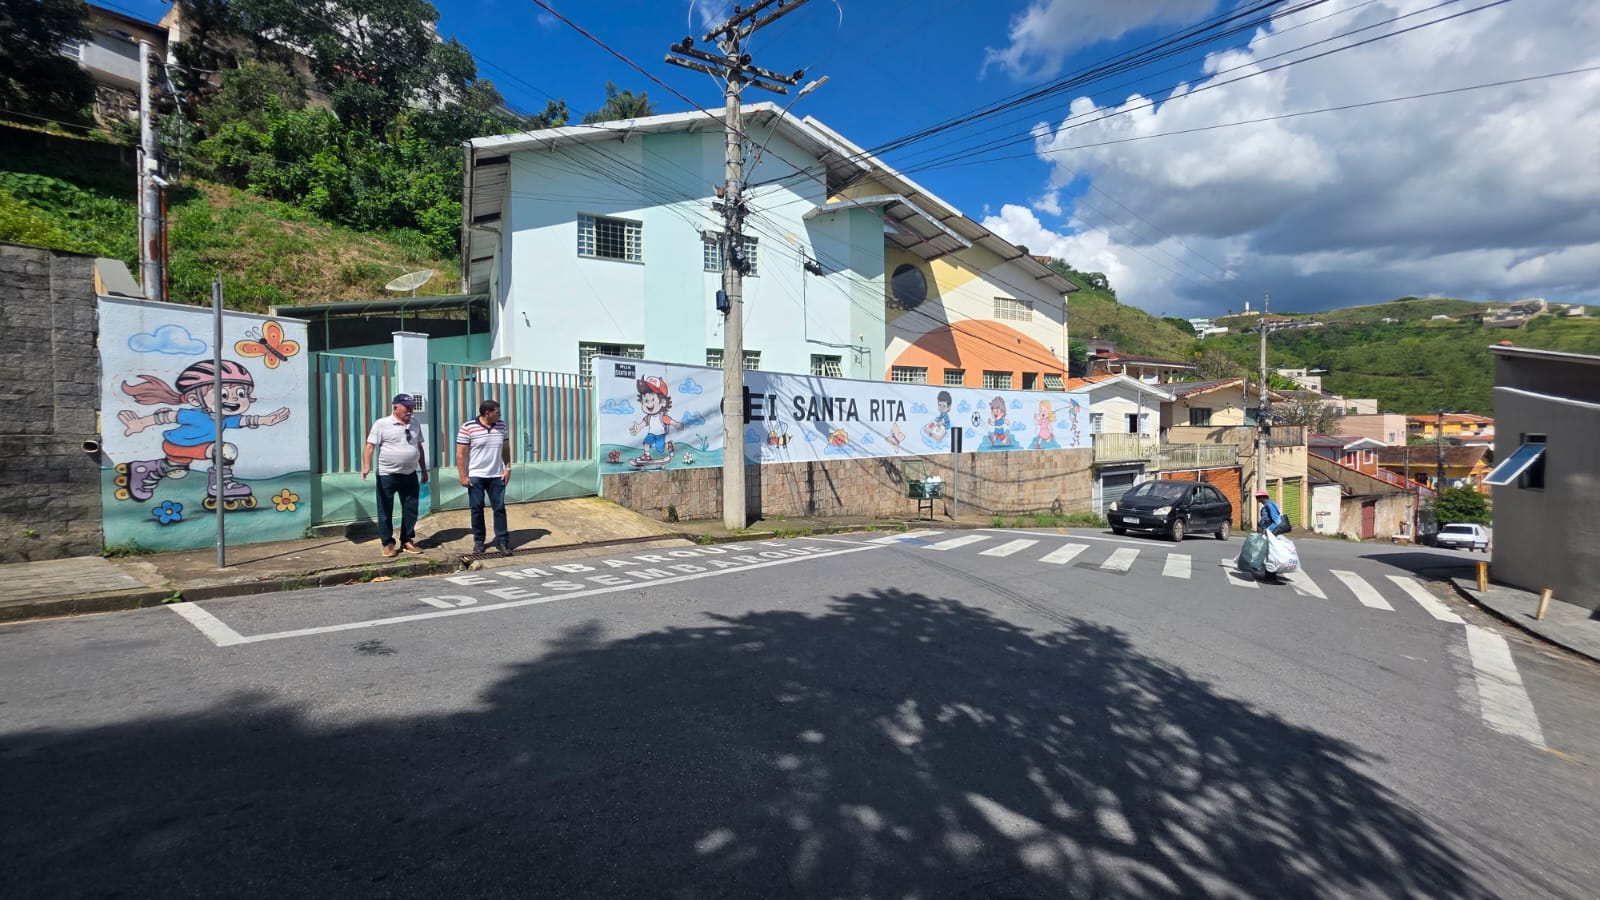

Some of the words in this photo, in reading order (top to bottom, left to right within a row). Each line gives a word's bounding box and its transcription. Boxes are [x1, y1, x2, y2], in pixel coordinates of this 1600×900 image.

[793, 395, 860, 422] SANTA
[870, 399, 907, 422] RITA
[418, 546, 833, 609] DESEMBARQUE
[444, 543, 753, 586] EMBARQUE
